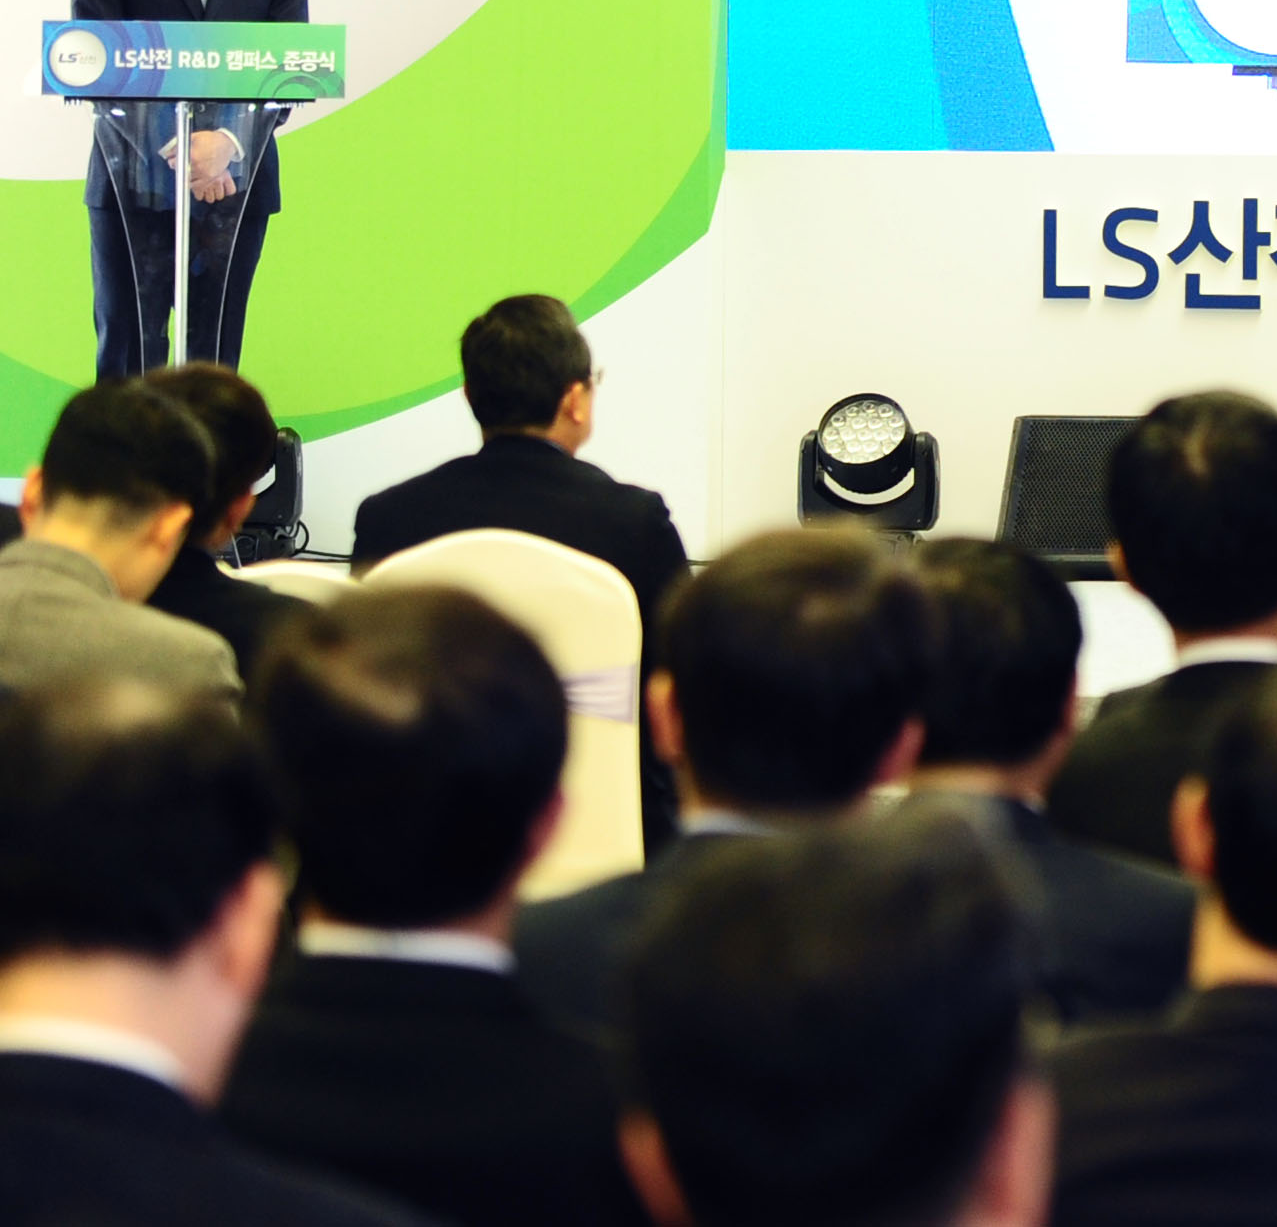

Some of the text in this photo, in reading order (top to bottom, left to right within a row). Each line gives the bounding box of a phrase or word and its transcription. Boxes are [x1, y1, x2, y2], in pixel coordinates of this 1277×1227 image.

[114, 49, 335, 72] LS산전 R&D 캠퍼스 준공식
